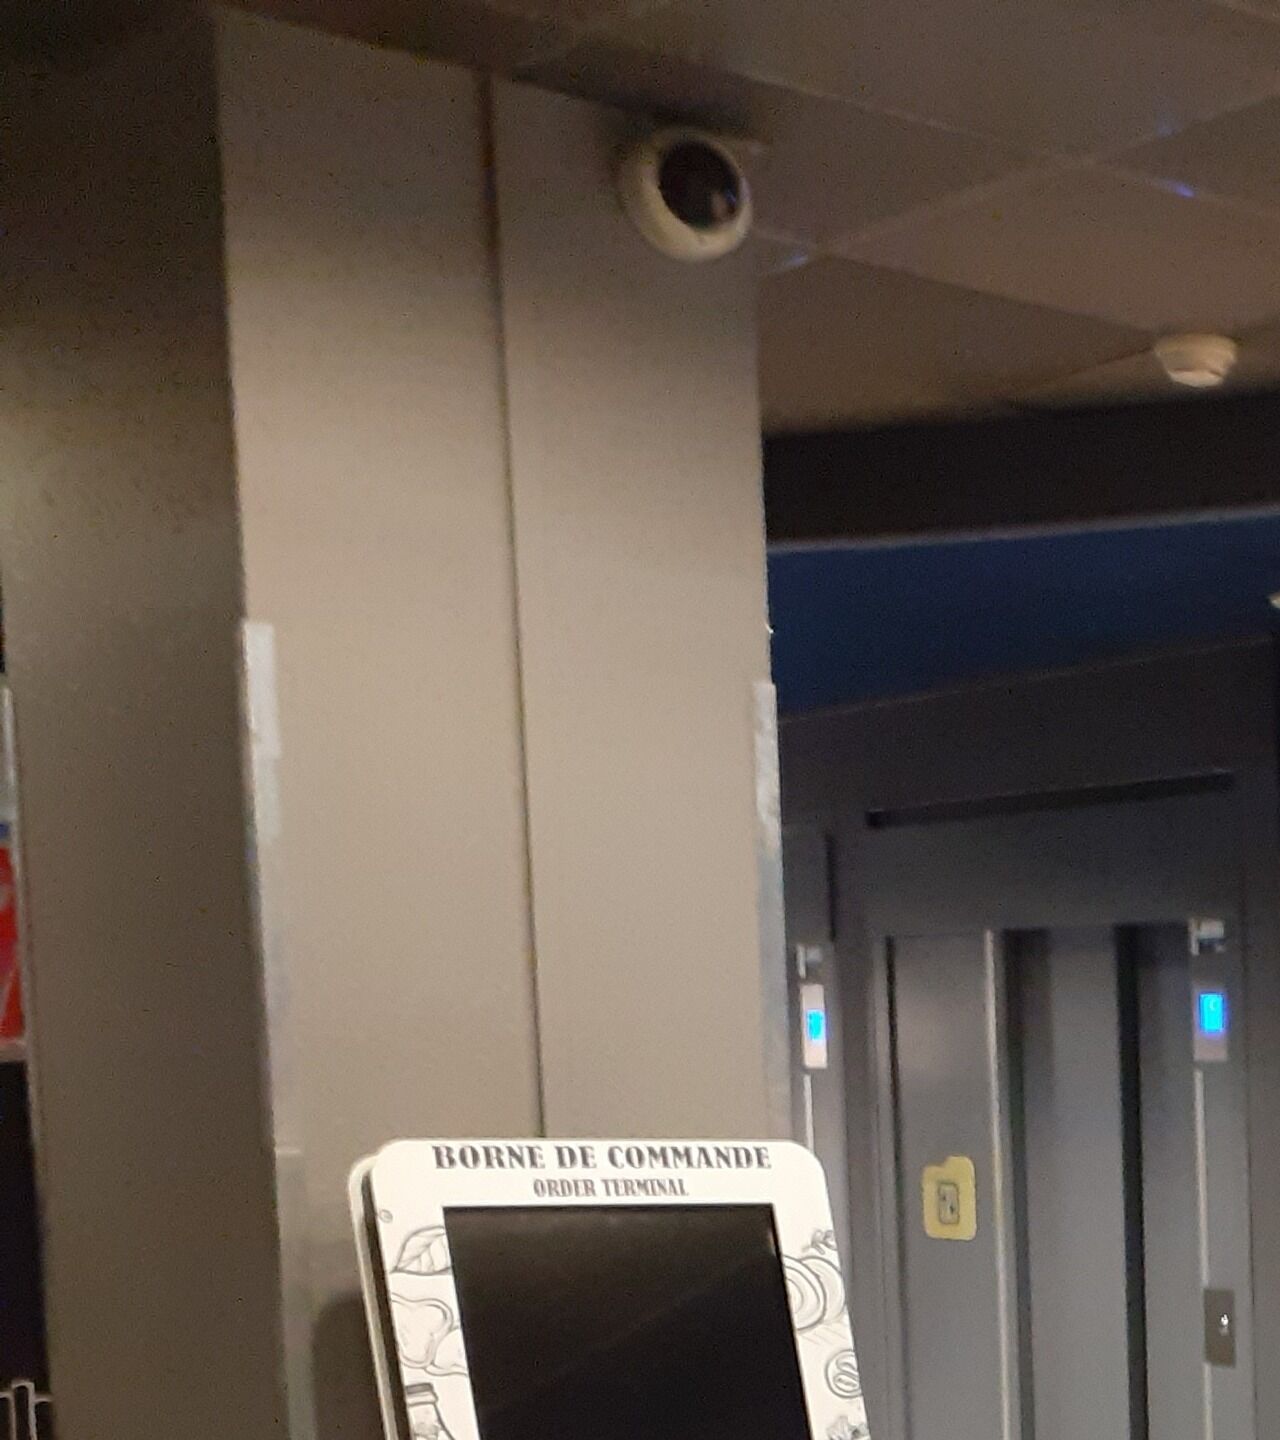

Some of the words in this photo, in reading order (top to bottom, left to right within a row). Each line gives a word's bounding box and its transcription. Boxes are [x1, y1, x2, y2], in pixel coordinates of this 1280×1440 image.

[432, 1145, 546, 1169] BORNE
[554, 1145, 597, 1169] DE
[607, 1145, 772, 1169] COMMANDE
[533, 1178, 597, 1197] ORDER
[600, 1178, 689, 1197] TERMINAL
